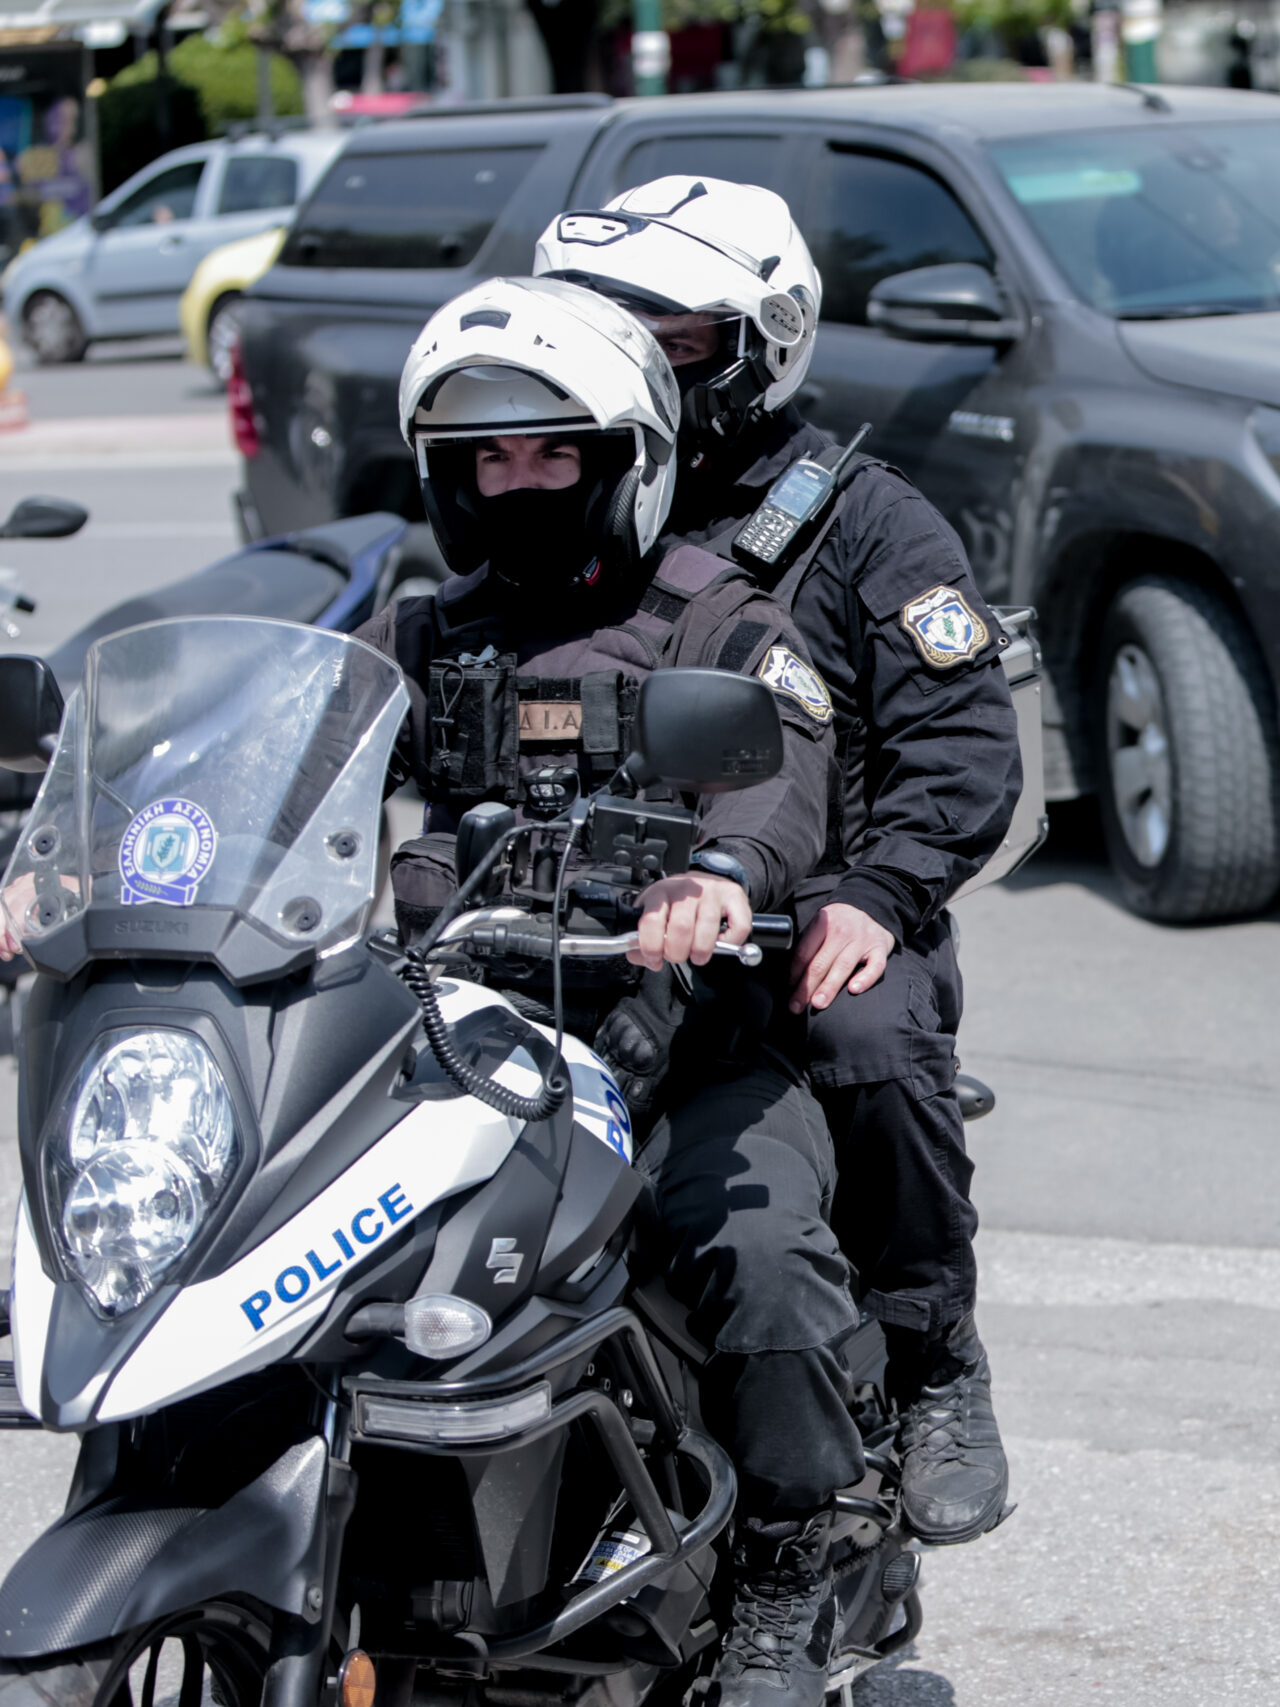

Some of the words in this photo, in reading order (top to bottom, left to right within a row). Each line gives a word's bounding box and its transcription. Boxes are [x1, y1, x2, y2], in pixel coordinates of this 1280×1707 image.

[123, 803, 165, 878] ΕΛΛΗΝΙΚΗ
[172, 802, 212, 879] ΑΣΤΥΝΟΜΙΑ
[114, 919, 189, 936] SUZUKI
[240, 1183, 414, 1332] POLICE
